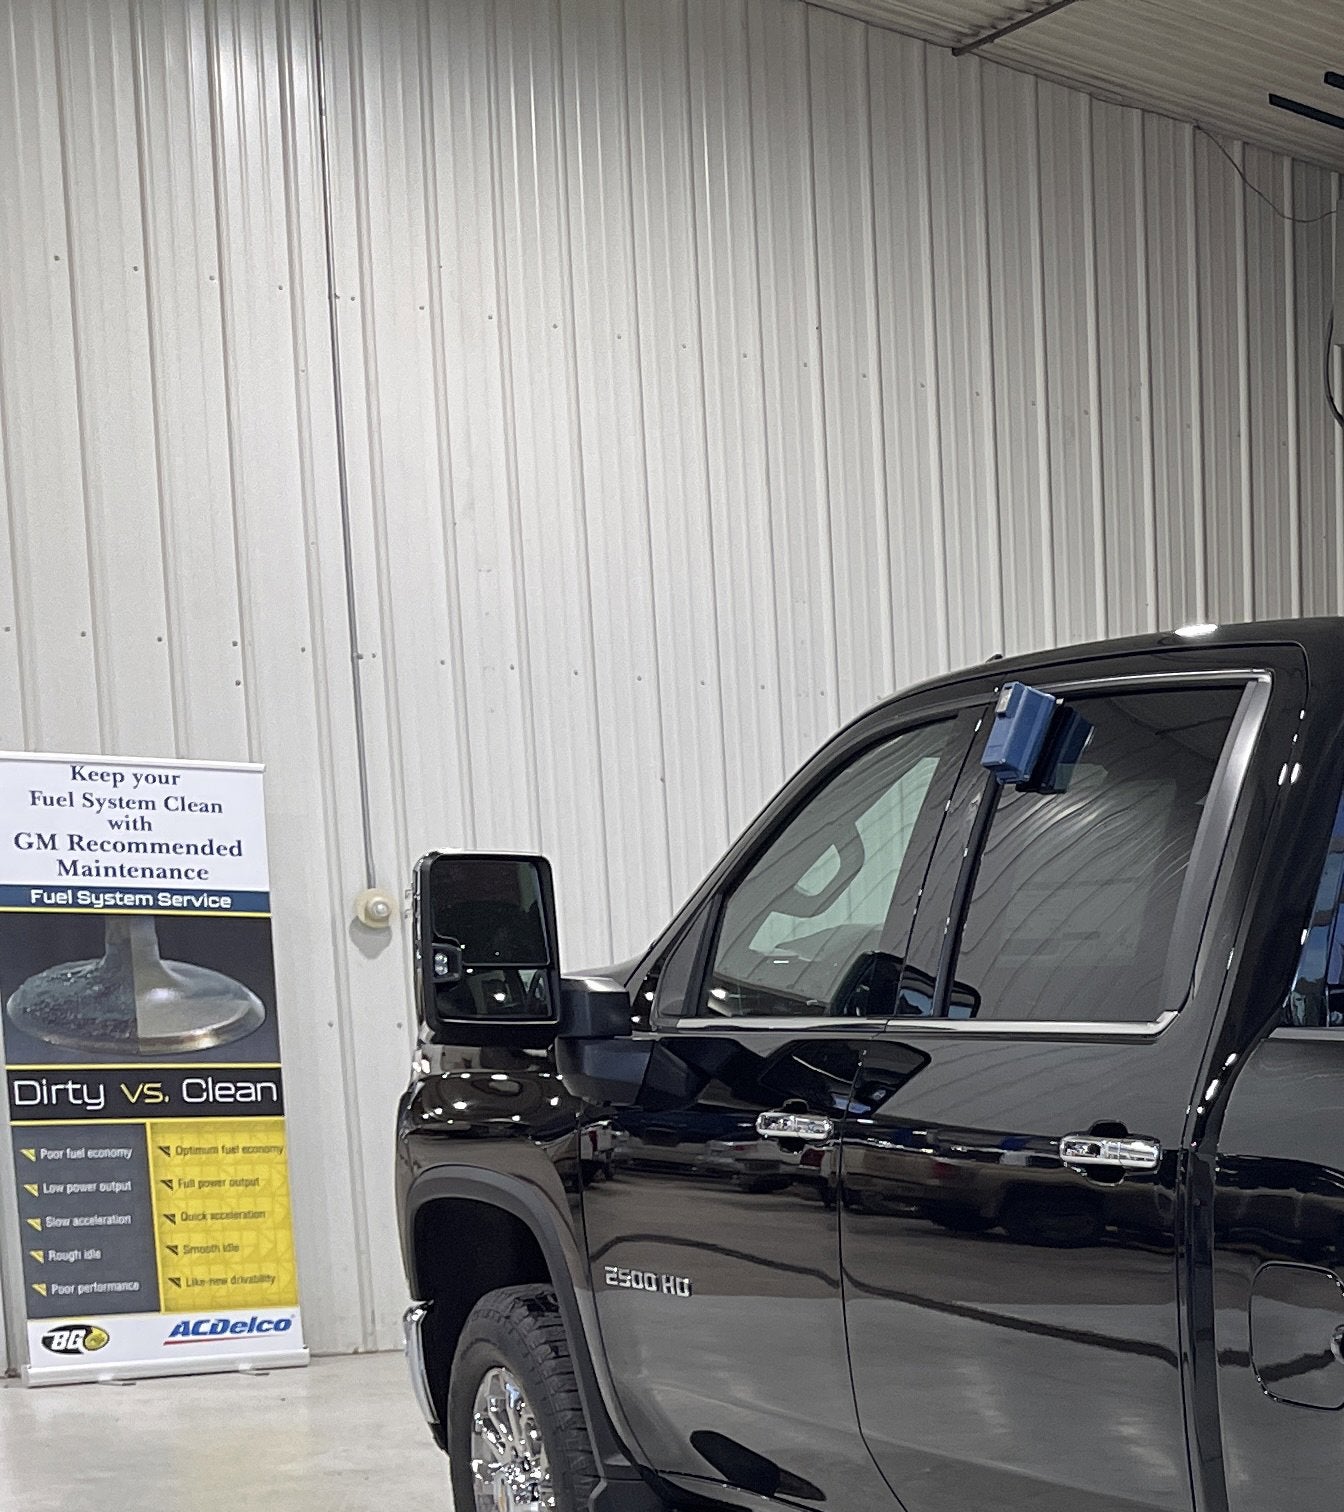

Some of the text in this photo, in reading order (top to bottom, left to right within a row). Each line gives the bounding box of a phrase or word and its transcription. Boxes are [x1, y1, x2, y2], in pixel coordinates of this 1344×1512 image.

[71, 765, 181, 789] Keep your
[29, 790, 223, 814] Fuel System Clean
[107, 815, 152, 831] with
[14, 832, 243, 857] GM Recommended
[57, 859, 209, 880] Maintenance
[30, 889, 232, 908] Fuel System Service
[13, 1076, 278, 1110] Dirty vs. Clean
[40, 1147, 132, 1160] Poor fuel economy
[175, 1145, 284, 1157] Optimum fuel economy
[43, 1181, 132, 1195] Low power output
[178, 1177, 260, 1190] Full power output
[45, 1215, 132, 1228] Slow acceleration
[180, 1210, 266, 1222] Quick acceleration
[48, 1249, 102, 1263] Rough idle
[183, 1244, 220, 1255] Smooth
[51, 1281, 140, 1296] Poor performance
[604, 1266, 691, 1298] 2500 HD
[168, 1316, 293, 1339] ACDelco
